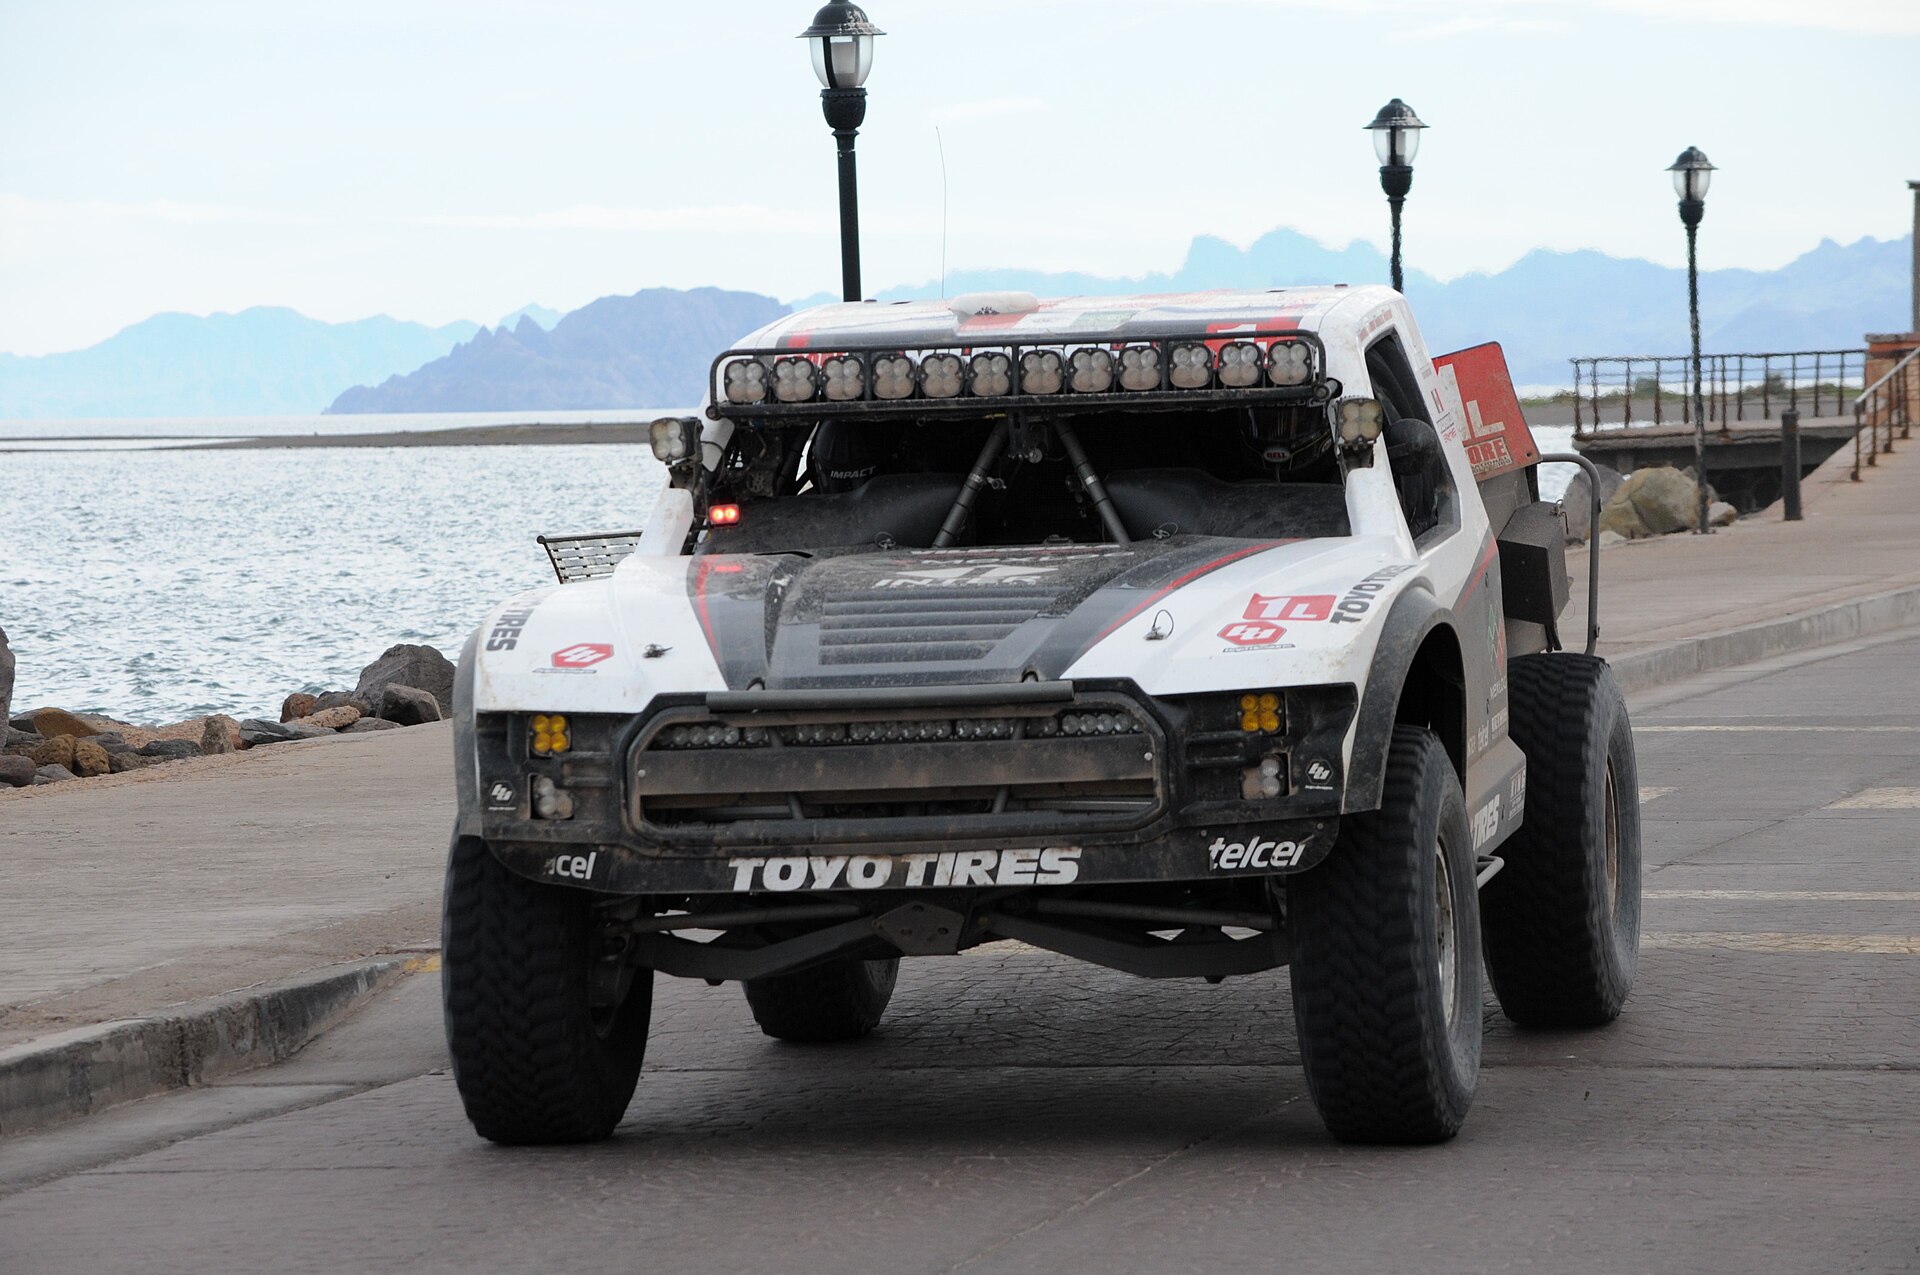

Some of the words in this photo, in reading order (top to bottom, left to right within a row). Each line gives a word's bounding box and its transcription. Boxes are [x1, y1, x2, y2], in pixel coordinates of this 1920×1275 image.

[831, 465, 876, 479] IMPACT
[1467, 440, 1507, 465] ORE
[1329, 583, 1384, 624] TOYO
[486, 608, 535, 651] TIRES
[728, 855, 893, 891] TOYO
[901, 847, 1082, 887] TIRES
